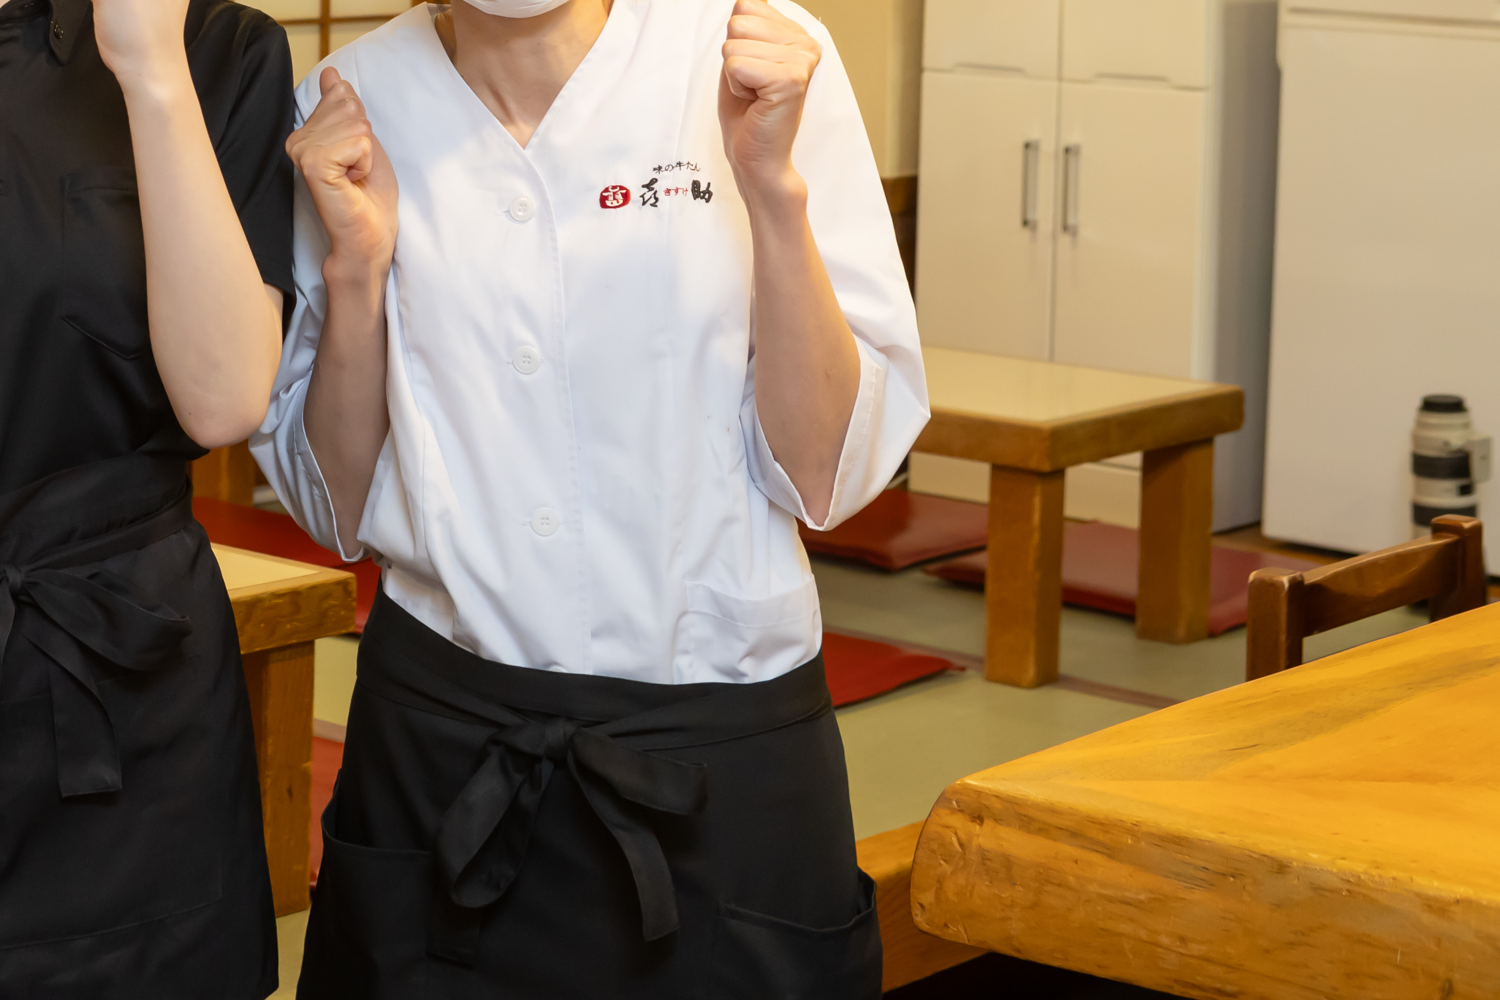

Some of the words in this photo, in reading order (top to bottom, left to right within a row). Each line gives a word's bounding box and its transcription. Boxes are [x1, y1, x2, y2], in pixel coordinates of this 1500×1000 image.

[652, 161, 701, 174] 味の牛たん
